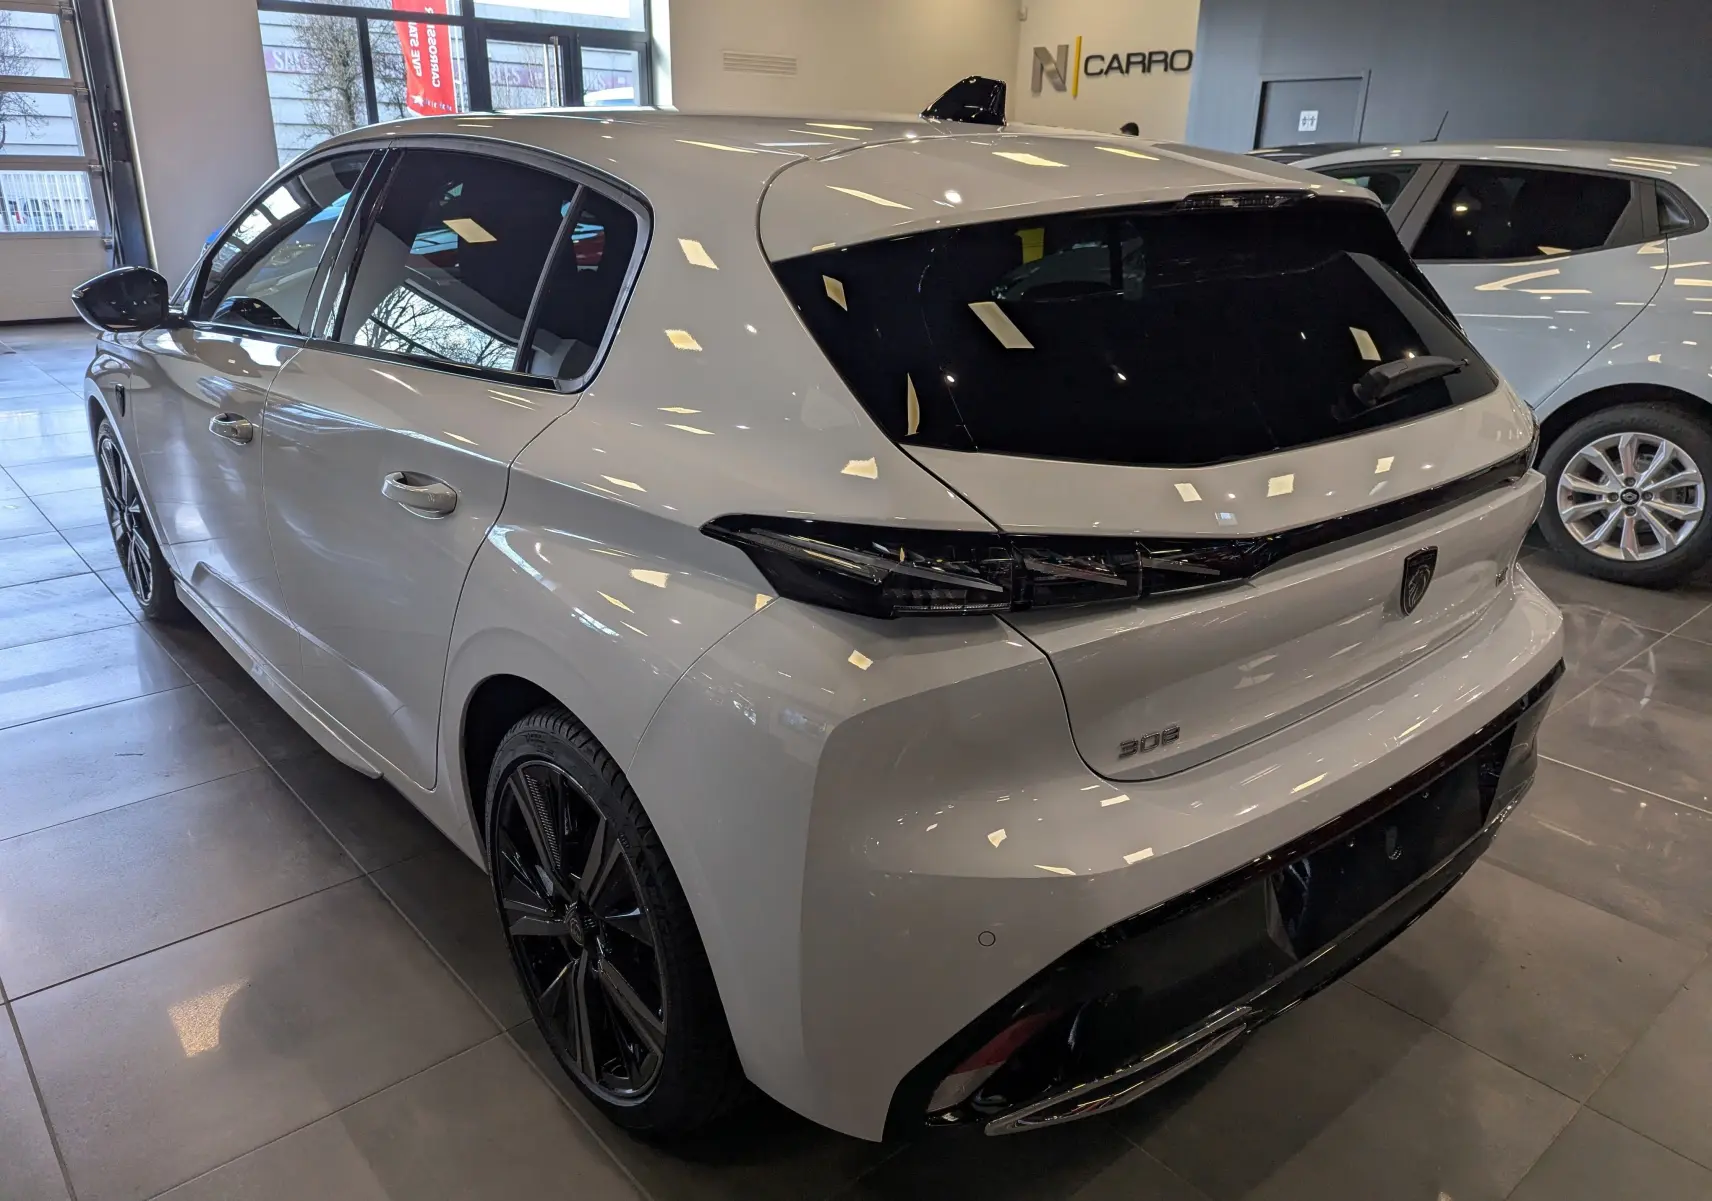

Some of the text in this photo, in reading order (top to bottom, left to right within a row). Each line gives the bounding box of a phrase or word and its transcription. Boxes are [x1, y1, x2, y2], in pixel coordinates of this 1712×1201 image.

[1031, 44, 1194, 94] N CARRO
[1118, 725, 1181, 759] 308
